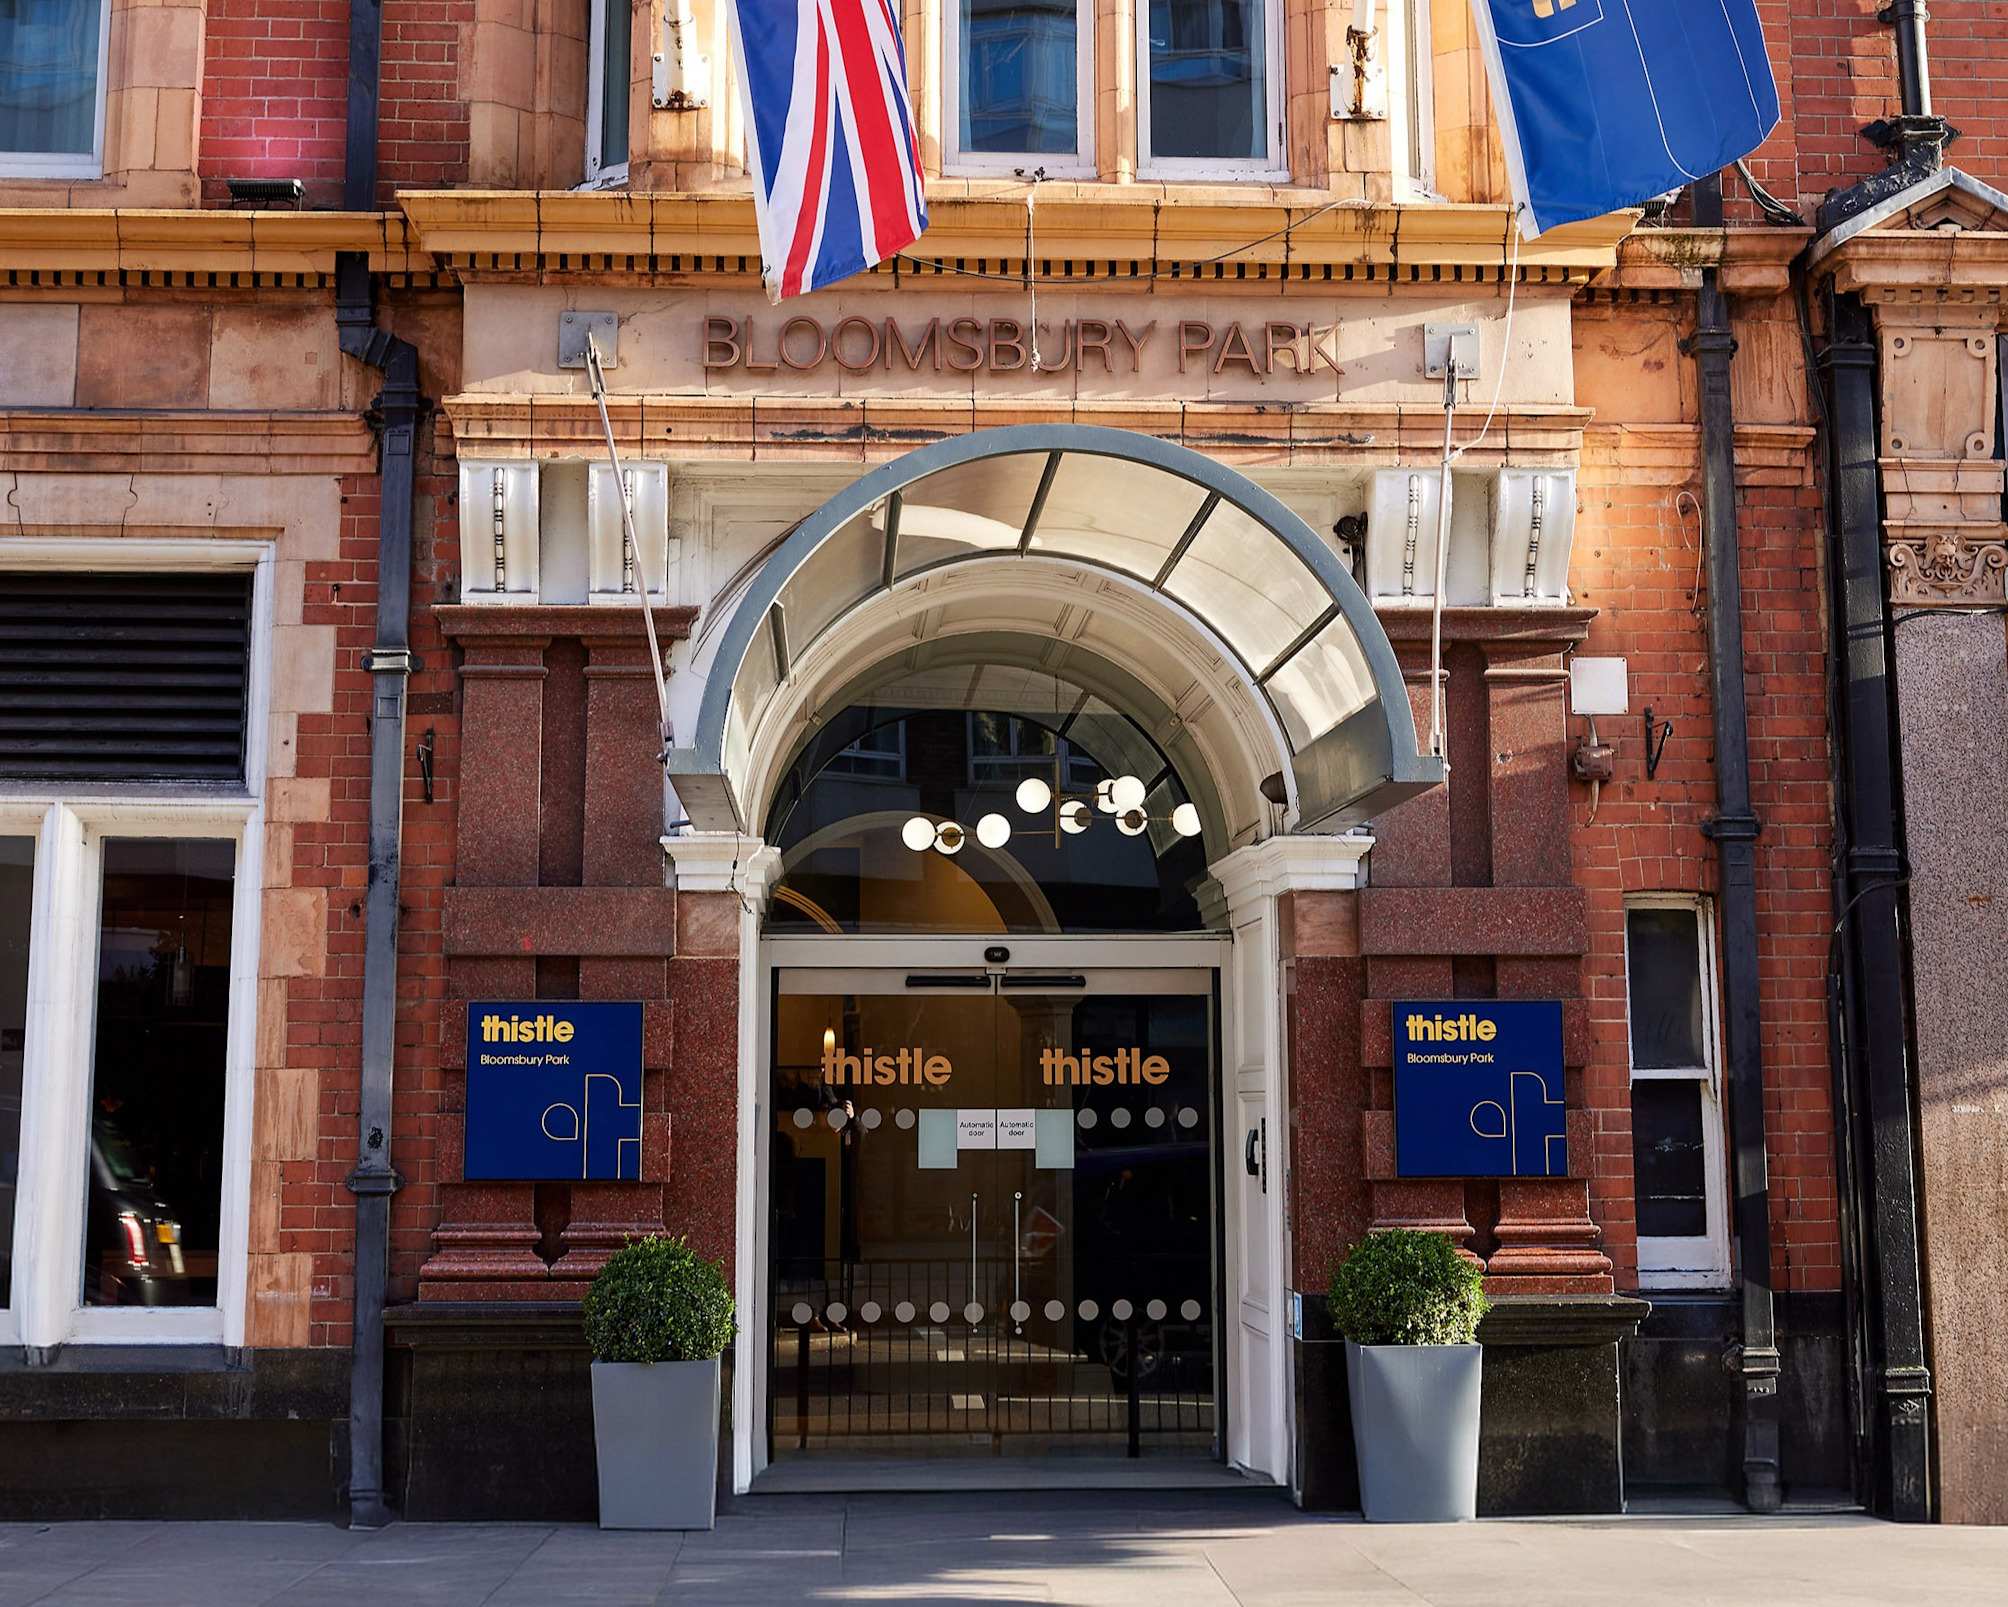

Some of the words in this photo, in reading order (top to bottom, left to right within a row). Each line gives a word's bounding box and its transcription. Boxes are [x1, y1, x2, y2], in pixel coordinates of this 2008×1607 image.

[703, 315, 1157, 373] BLOOMSBURY
[1179, 319, 1346, 377] PARK
[481, 1015, 575, 1043] thistle
[1406, 1014, 1497, 1042] thistle
[480, 1054, 543, 1067] Bloomsbury
[545, 1054, 570, 1065] Park
[1407, 1053, 1469, 1065] Bloomsbury
[1470, 1053, 1494, 1064] Park
[821, 1047, 952, 1085] thistle
[1040, 1047, 1170, 1085] thistle
[959, 1121, 994, 1129] Automatic
[1000, 1121, 1034, 1129] Automatic
[968, 1129, 985, 1137] door
[1008, 1128, 1025, 1137] door
